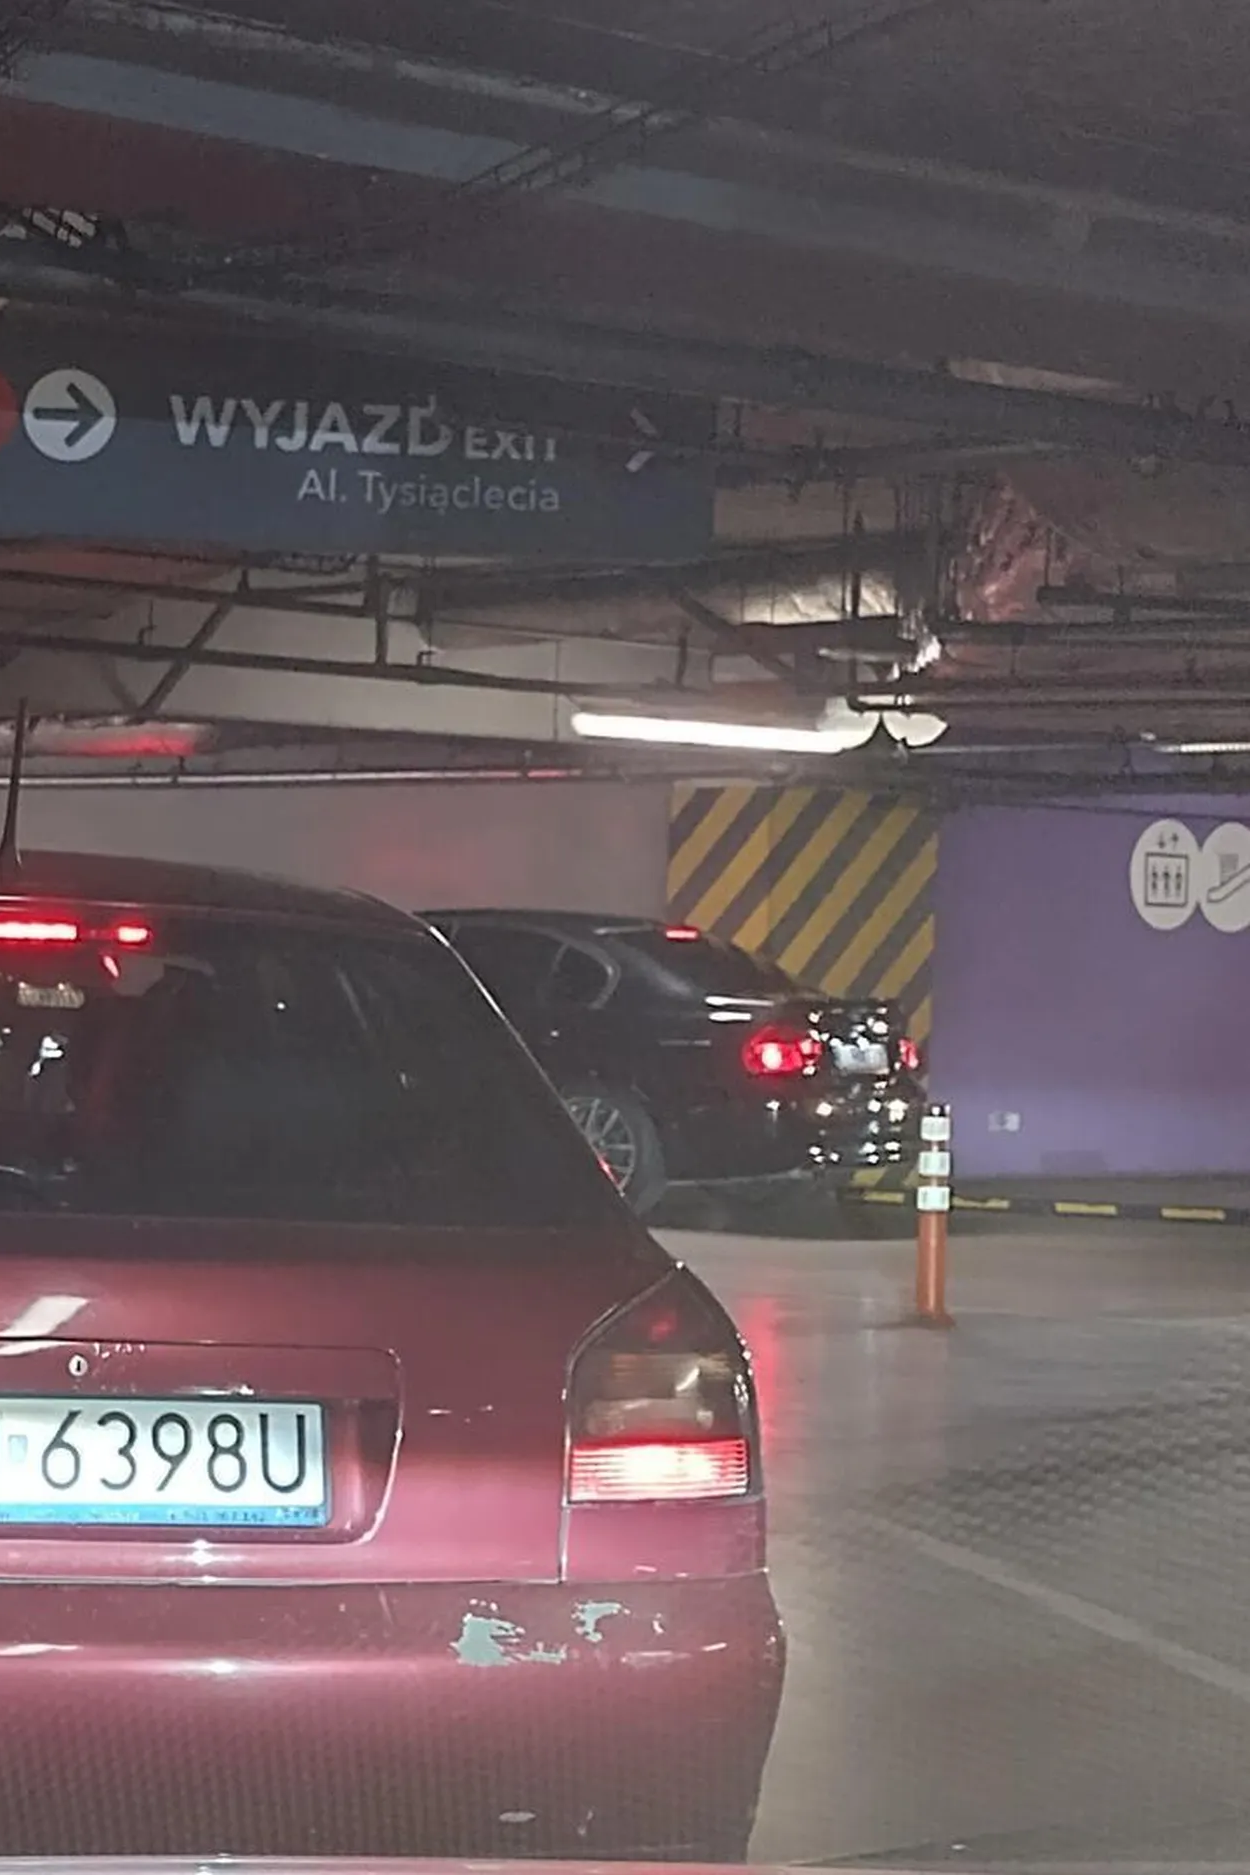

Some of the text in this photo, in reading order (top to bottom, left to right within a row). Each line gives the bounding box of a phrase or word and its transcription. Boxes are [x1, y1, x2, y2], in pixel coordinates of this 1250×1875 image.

[169, 394, 452, 456] WYJAZD
[298, 467, 559, 516] Al. Tysiąclecia
[40, 1409, 307, 1494] 6398U
